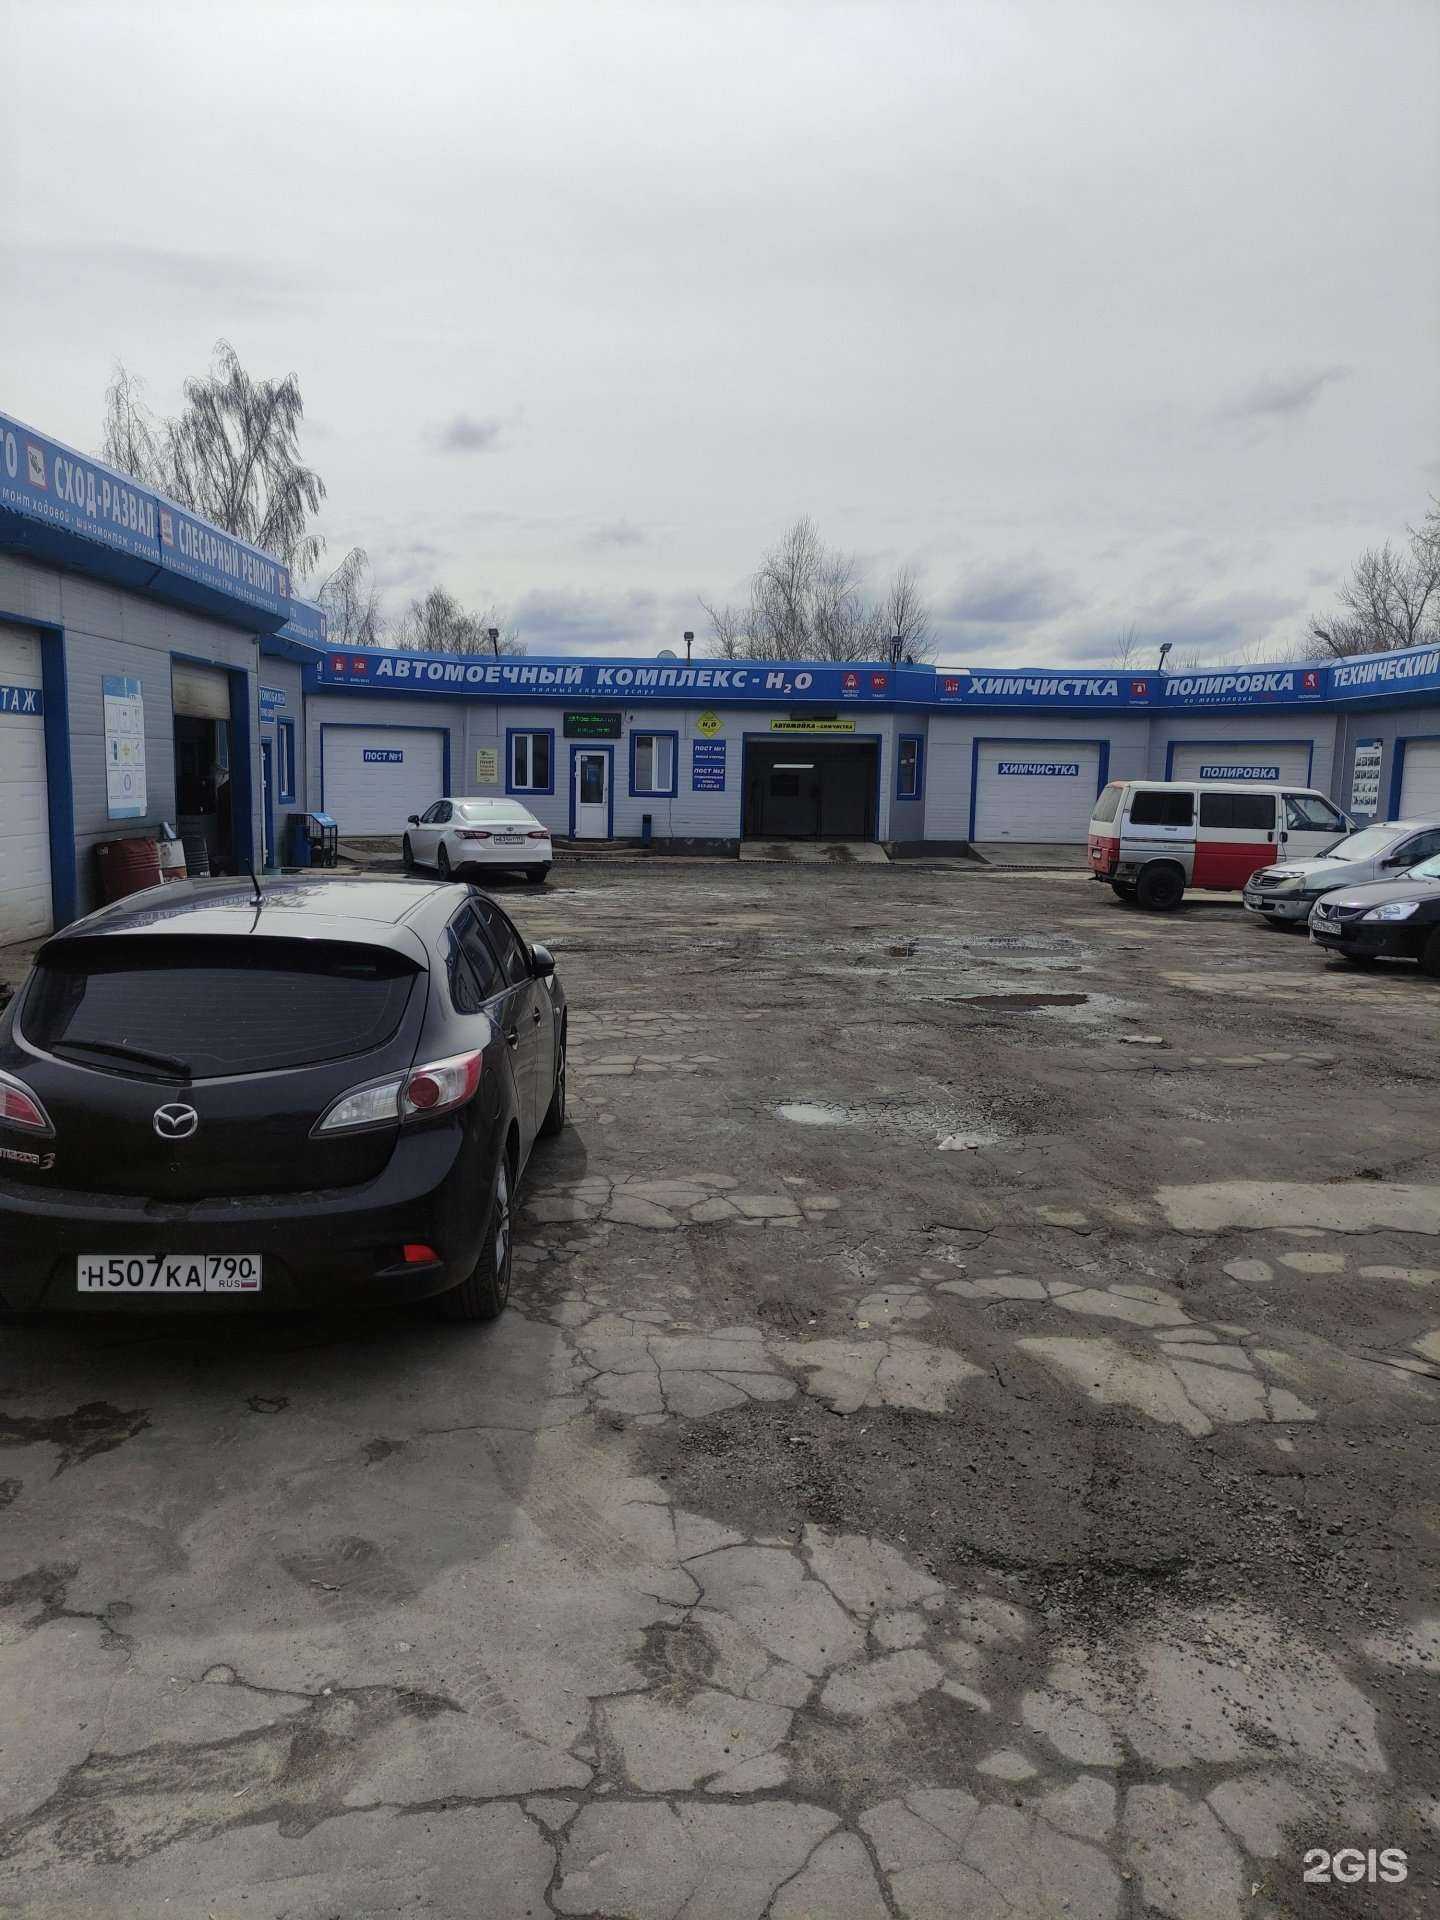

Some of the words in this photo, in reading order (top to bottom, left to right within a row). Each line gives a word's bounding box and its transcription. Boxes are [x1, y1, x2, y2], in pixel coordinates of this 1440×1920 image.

[0, 428, 17, 478] О
[54, 456, 154, 539] СХОД-РАЗВАЛ
[178, 519, 239, 579] СЛЕСАРНЫЙ
[242, 551, 275, 595] РЕМОНТ
[376, 657, 584, 685] АВТОМОЕЧНЫЙ
[596, 668, 748, 688] КОМПЛЕКС
[1334, 649, 1440, 687] ТЕХНИЧЕСКИЙ
[968, 677, 1118, 696] ХИМЧИСТКА
[1165, 672, 1294, 696] ПОЛИРОВКА
[1, 687, 36, 711] ТАЖ
[365, 751, 387, 760] ПОСТ
[1000, 763, 1076, 775] ХИМЧИСТКА
[1202, 767, 1276, 779] ПОЛИРОВКА
[208, 1257, 253, 1279] 790
[218, 1280, 240, 1288] RUS
